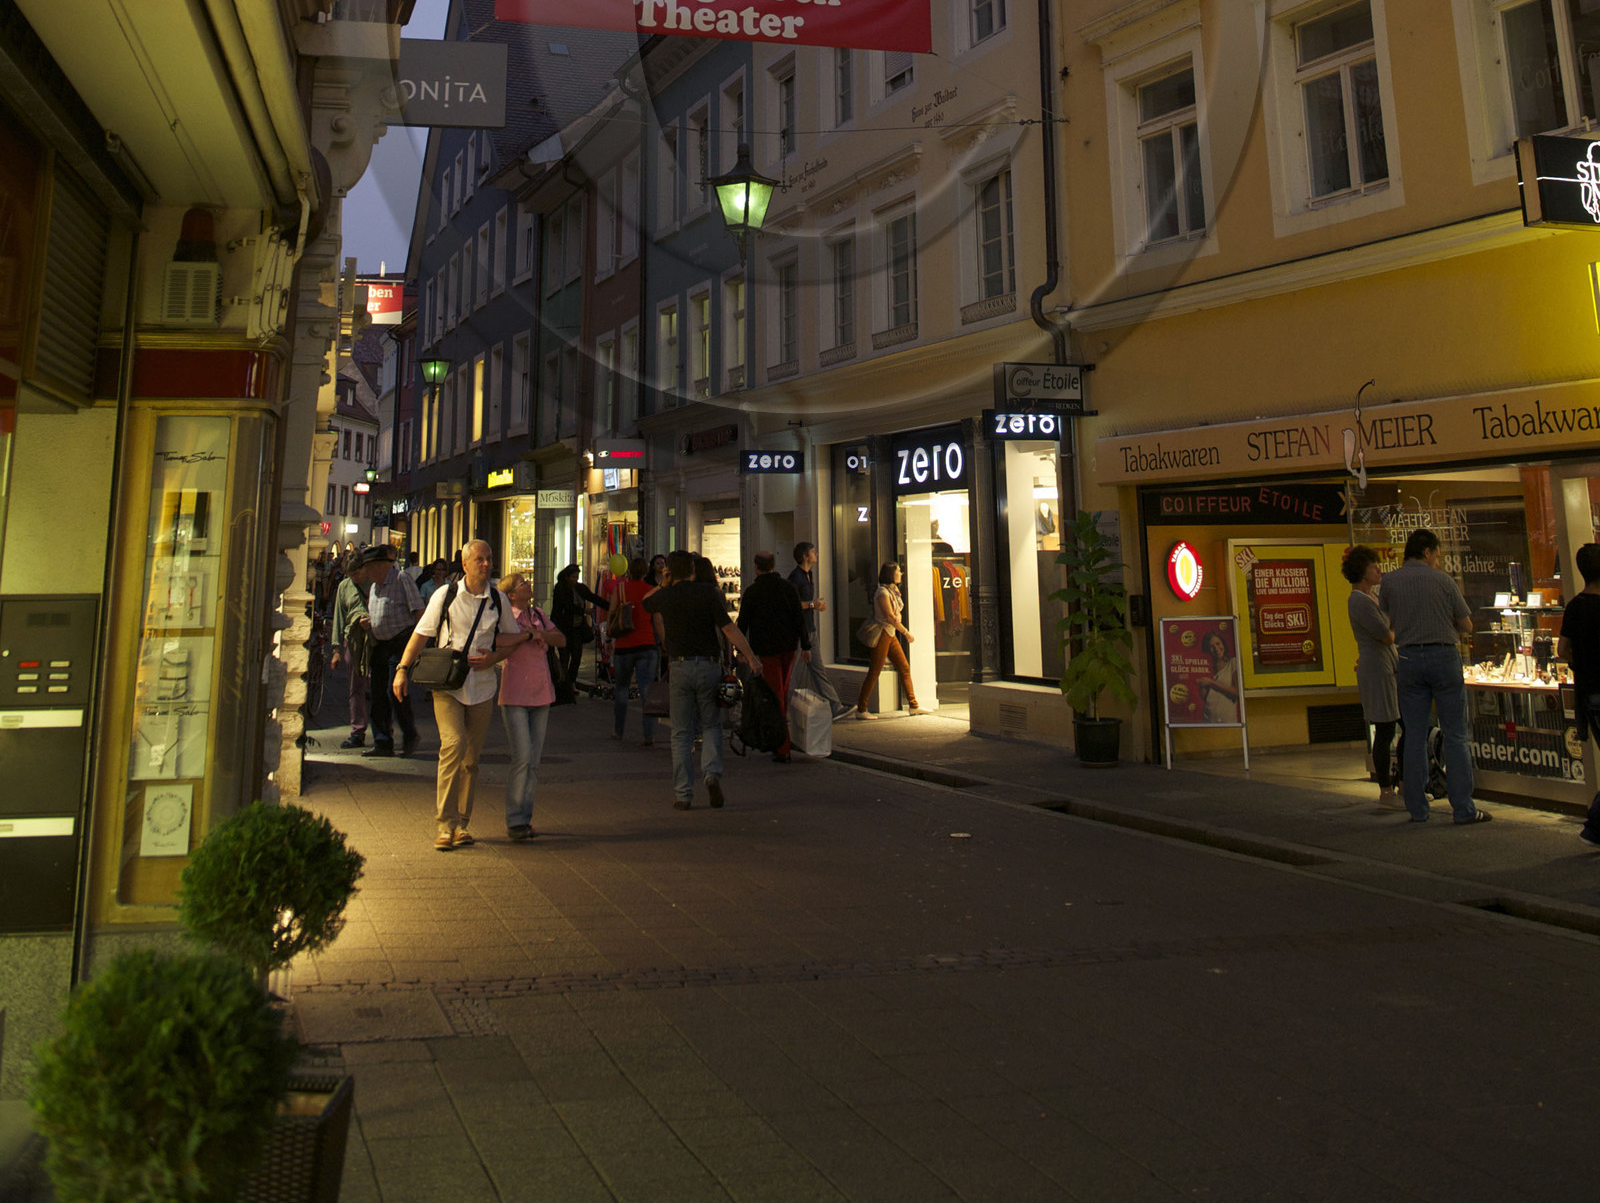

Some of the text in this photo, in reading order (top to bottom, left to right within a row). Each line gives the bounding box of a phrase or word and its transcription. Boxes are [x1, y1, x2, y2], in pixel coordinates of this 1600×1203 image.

[1043, 368, 1080, 390] Étoile
[994, 414, 1055, 434] zero
[1120, 400, 1600, 473] Tabakwaren STEFAN MEIER Tabakwar
[748, 454, 796, 469] zero
[897, 442, 963, 486] zero
[1162, 487, 1324, 519] COIFFEUR ETOILE
[1254, 567, 1308, 578] EINER KASSIERT
[1443, 554, 1461, 574] 88
[1463, 555, 1496, 574] Jahre
[1255, 576, 1310, 588] DIE MILLION!
[1286, 611, 1305, 627] SKL
